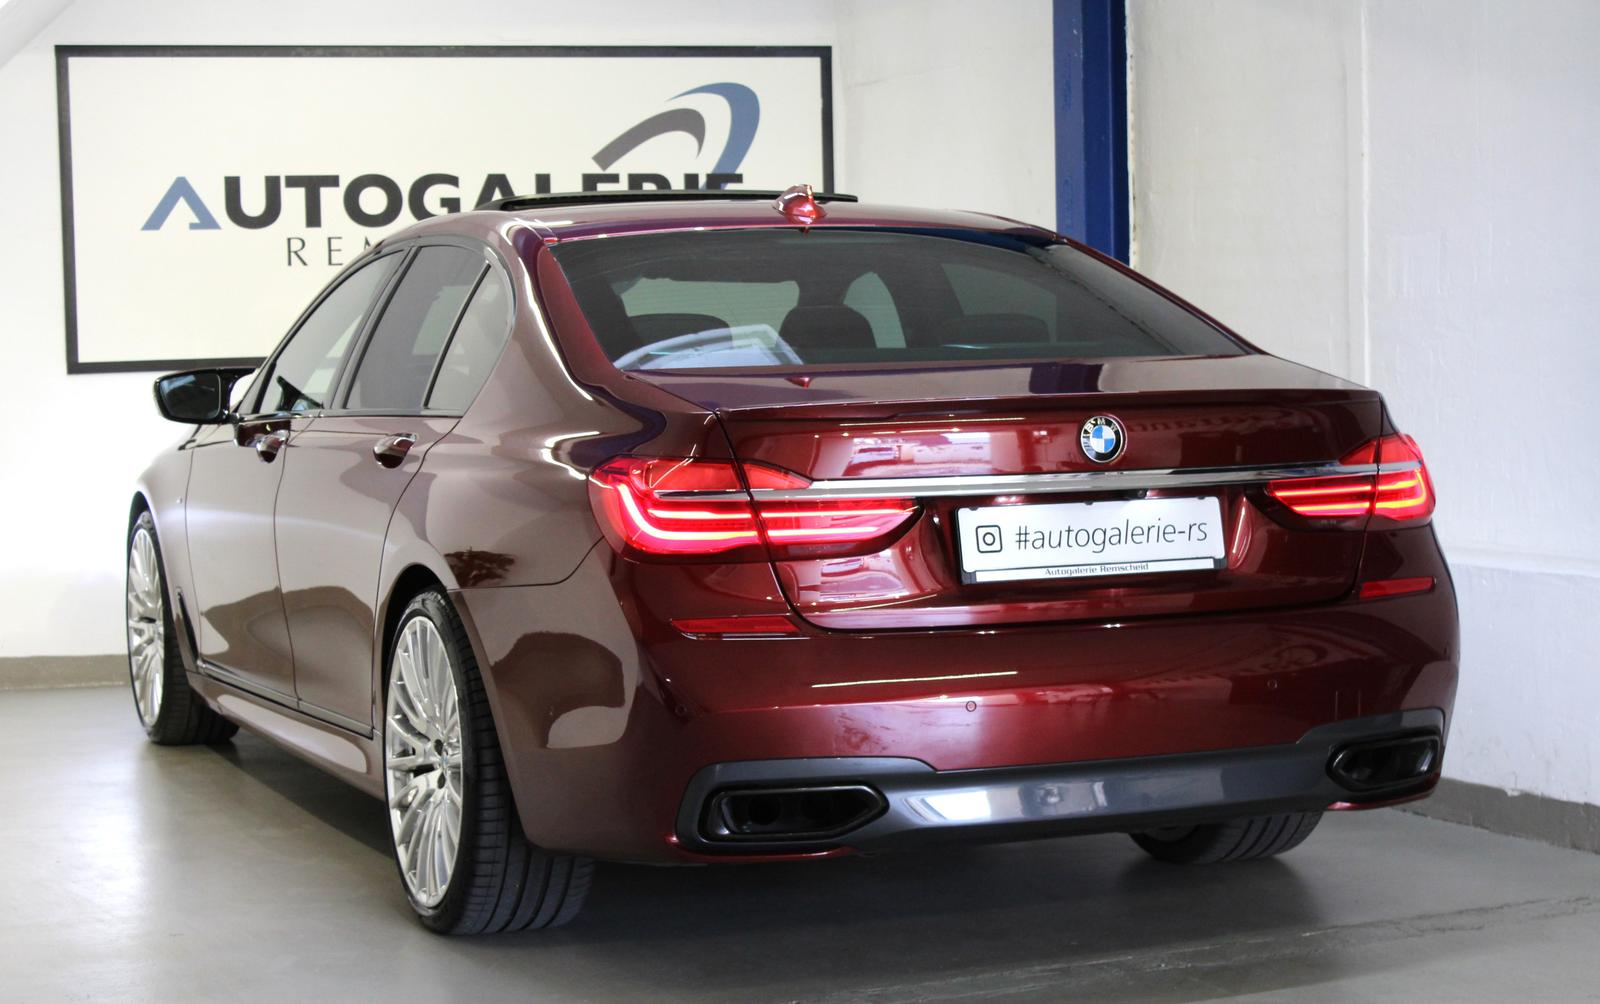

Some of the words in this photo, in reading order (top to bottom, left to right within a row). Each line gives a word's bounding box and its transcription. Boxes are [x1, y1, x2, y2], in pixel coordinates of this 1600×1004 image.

[1084, 417, 1118, 432] BMW
[1015, 518, 1208, 553] #autogalerie-rs
[1044, 566, 1098, 577] Autogalerie
[1100, 563, 1150, 574] Remscheid
